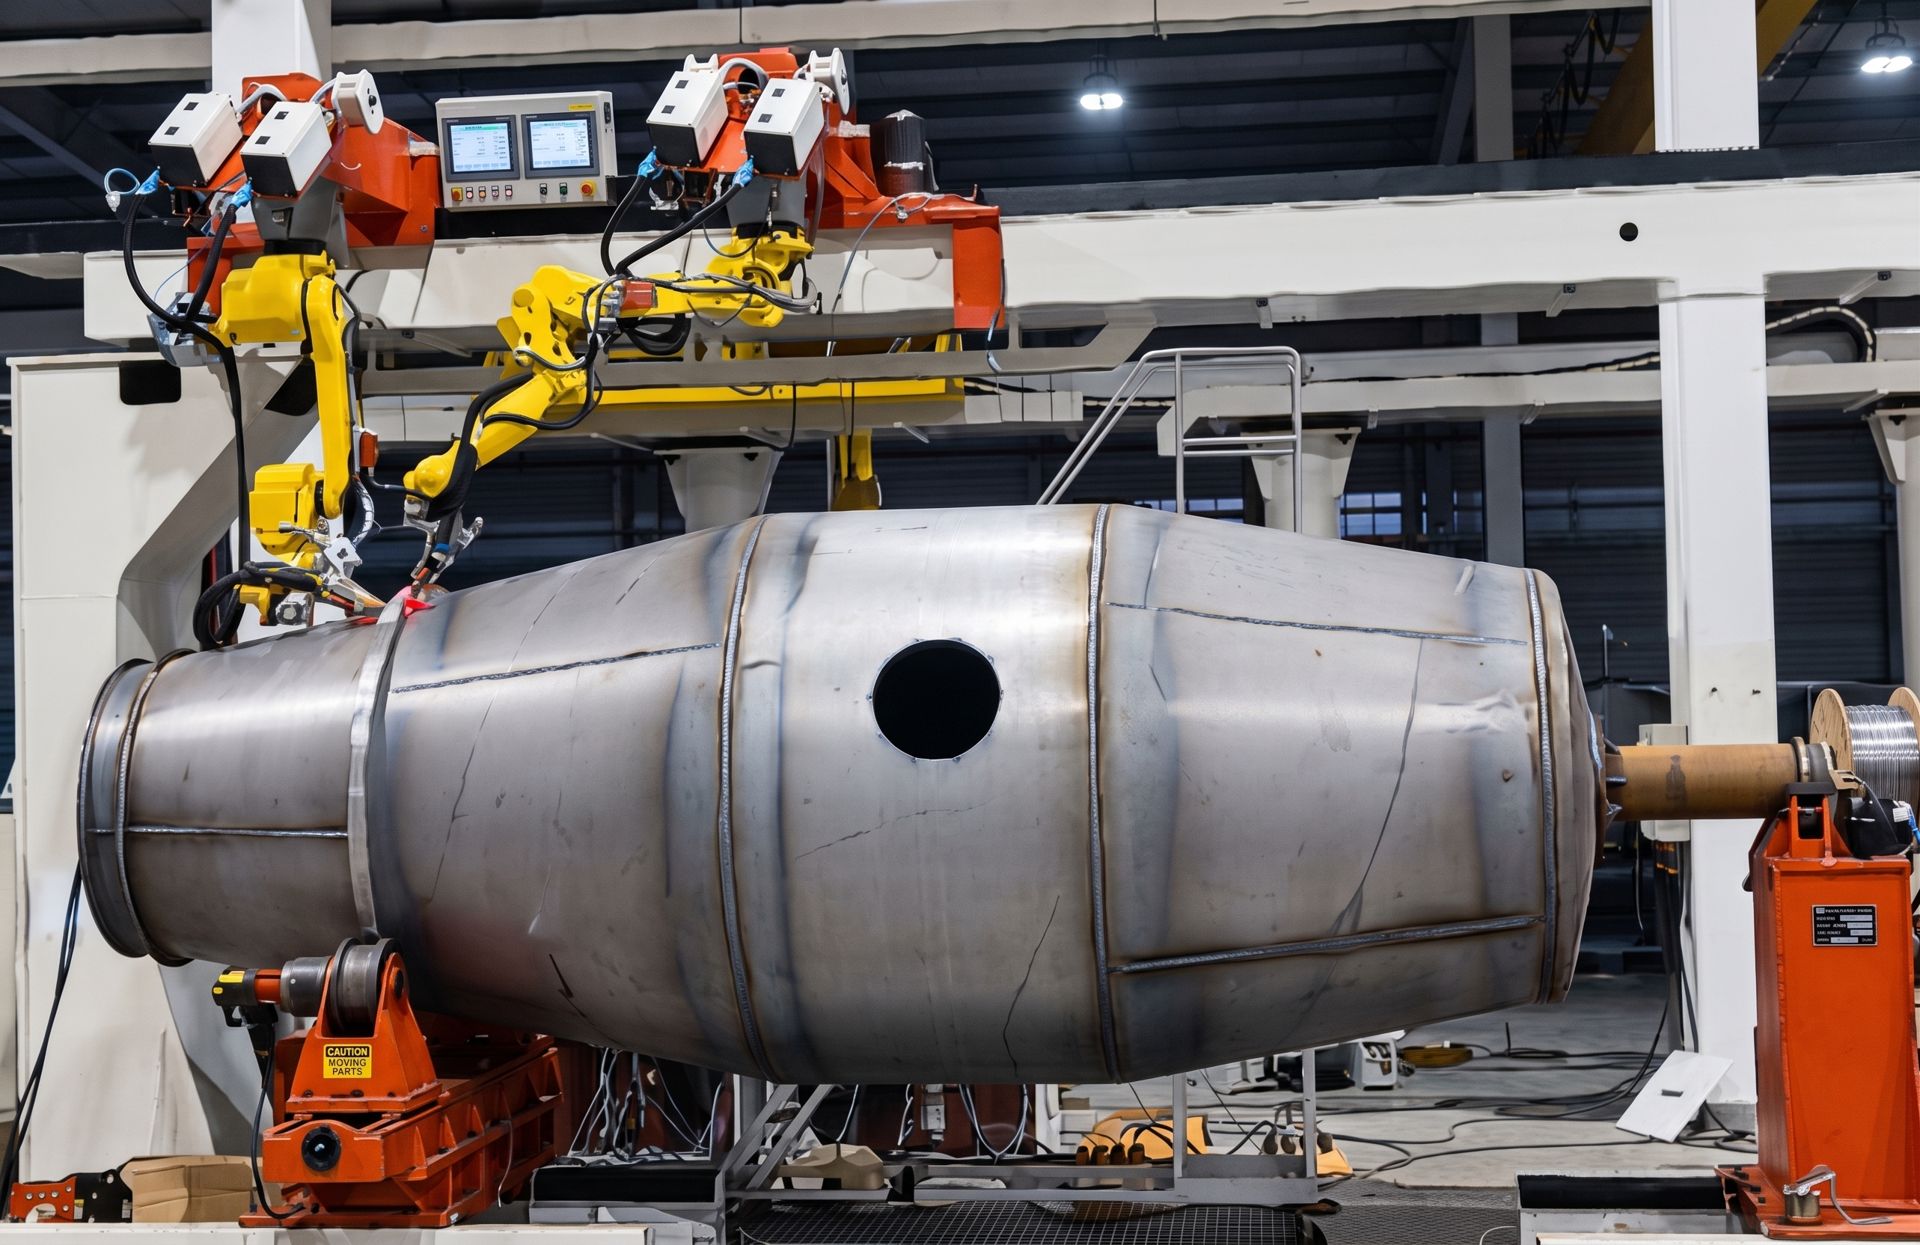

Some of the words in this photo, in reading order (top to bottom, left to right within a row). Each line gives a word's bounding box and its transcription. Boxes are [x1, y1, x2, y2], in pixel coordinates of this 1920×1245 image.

[327, 1047, 368, 1056] CAUTION
[328, 1058, 367, 1067] MOVING
[332, 1067, 363, 1075] PARTS
